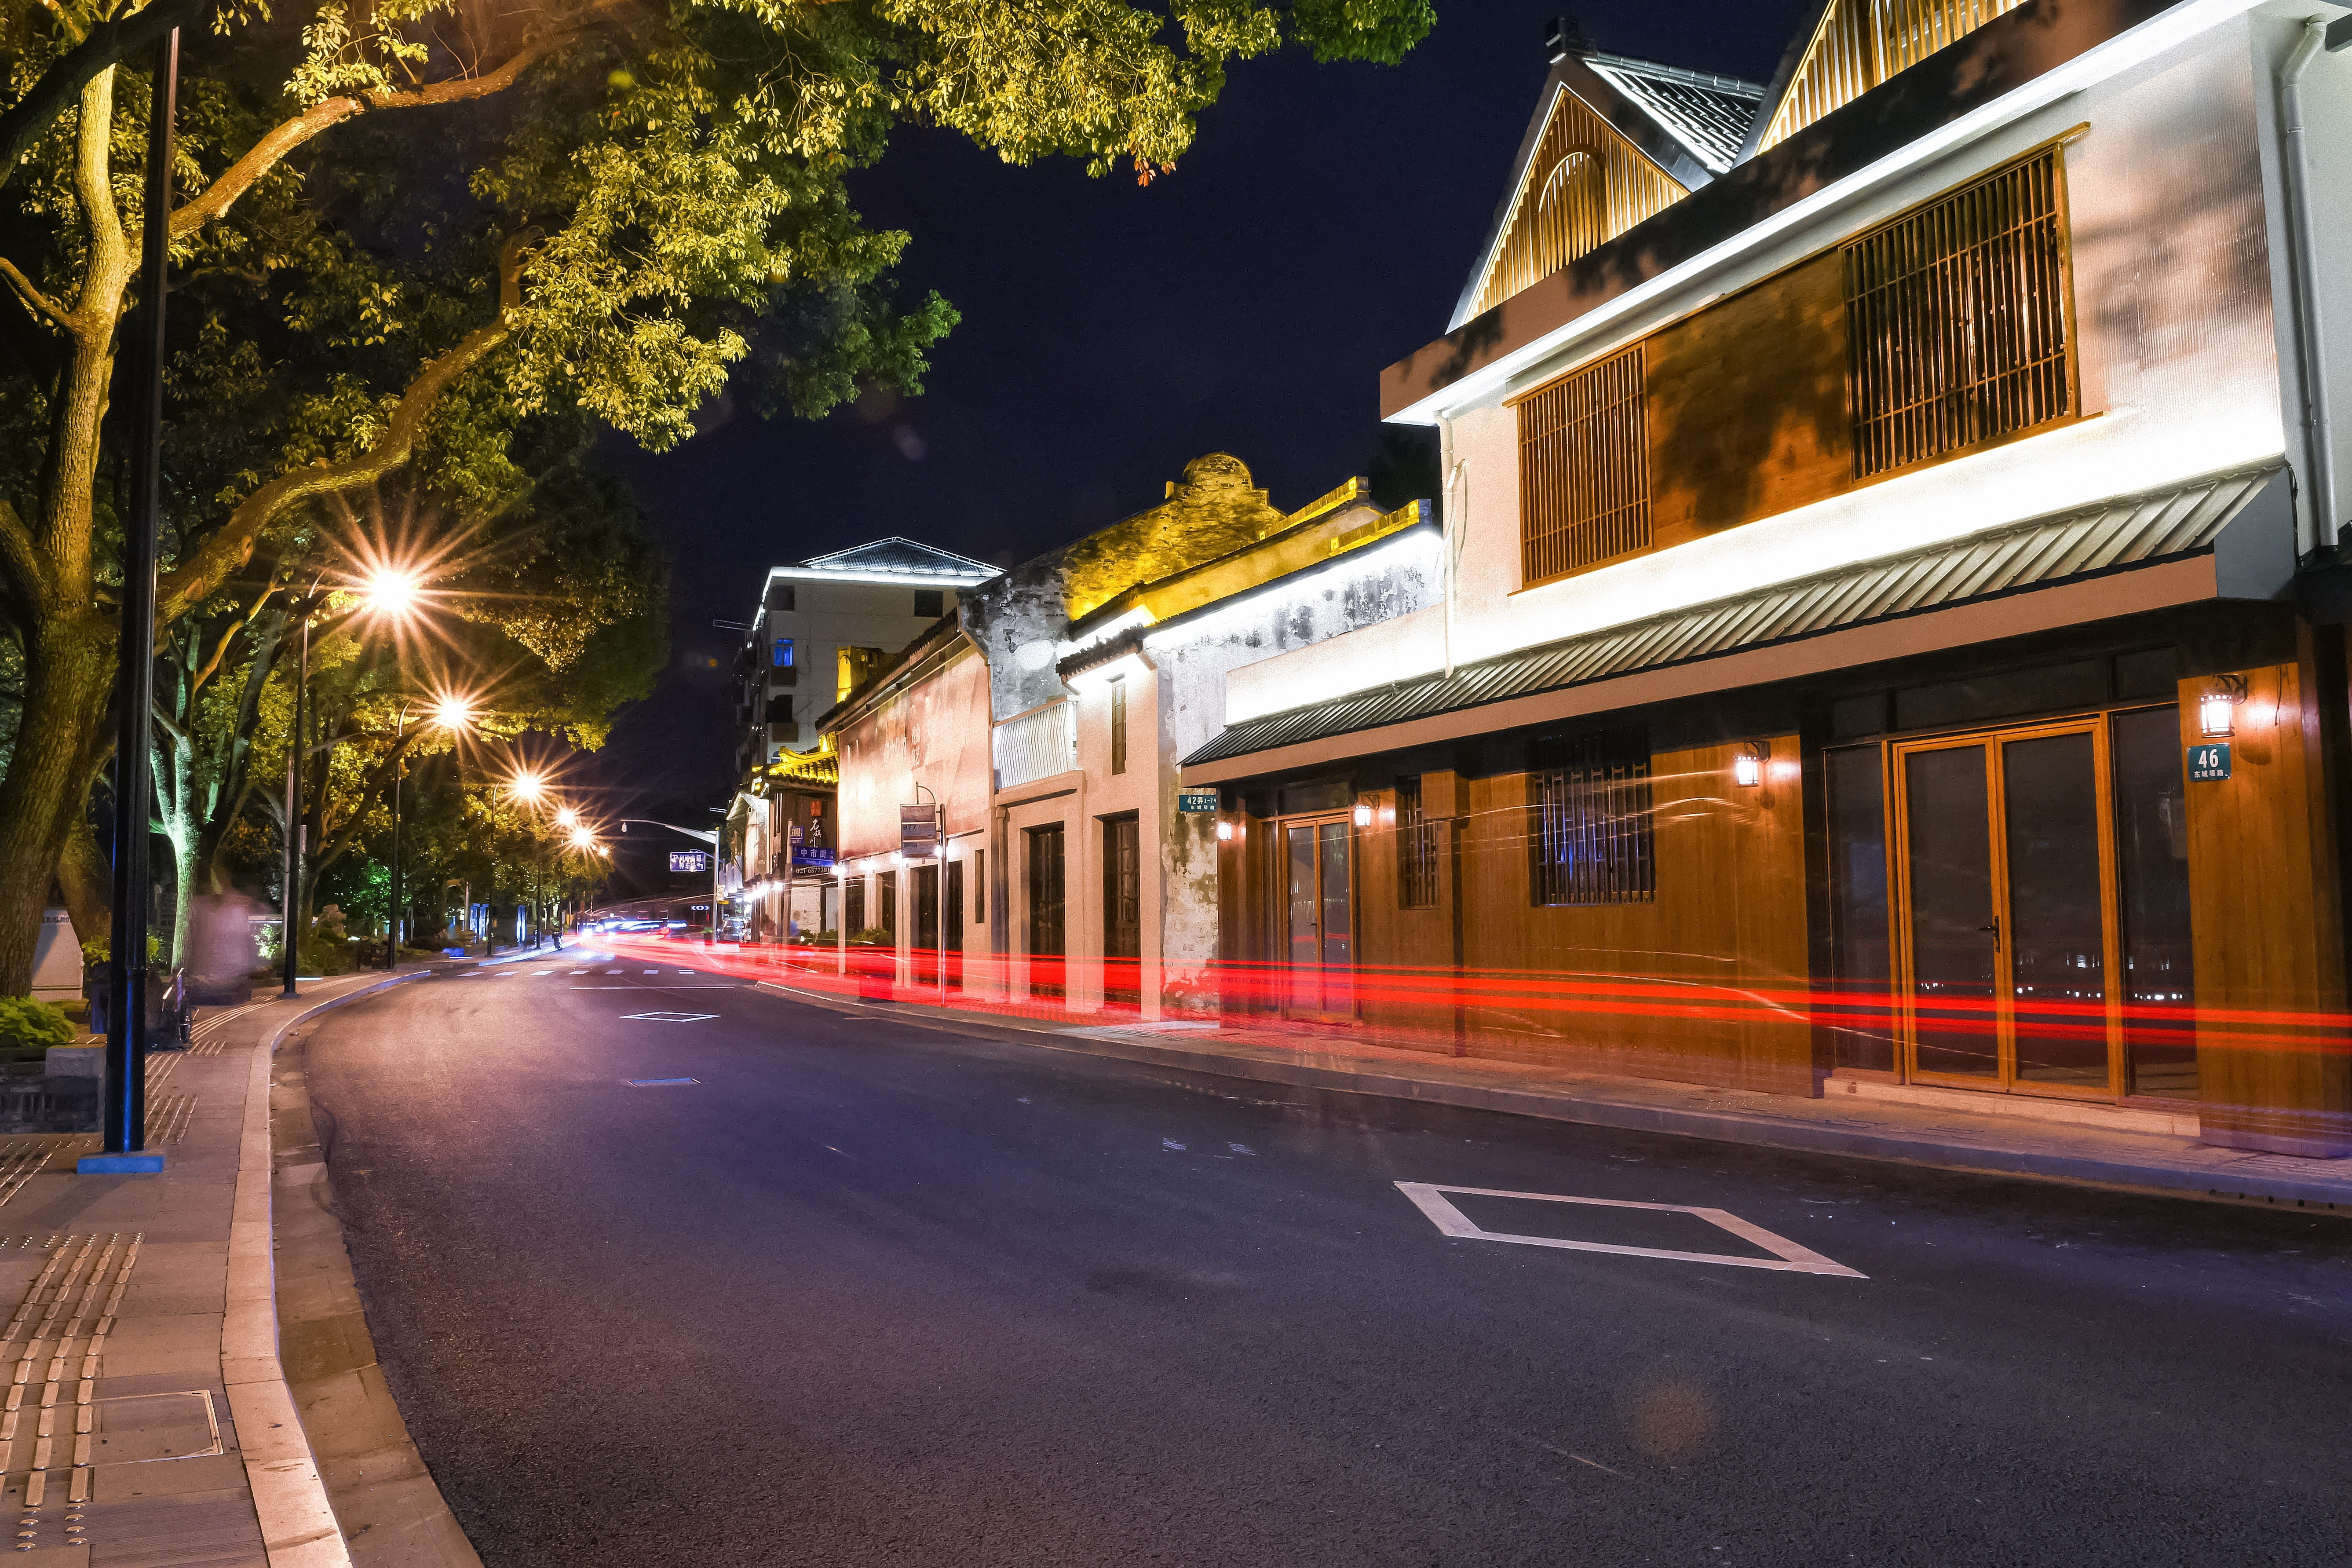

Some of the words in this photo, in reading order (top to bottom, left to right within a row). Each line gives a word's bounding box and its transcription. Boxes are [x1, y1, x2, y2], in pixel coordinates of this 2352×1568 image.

[2198, 749, 2218, 768] 46
[801, 848, 826, 858] 中市街
